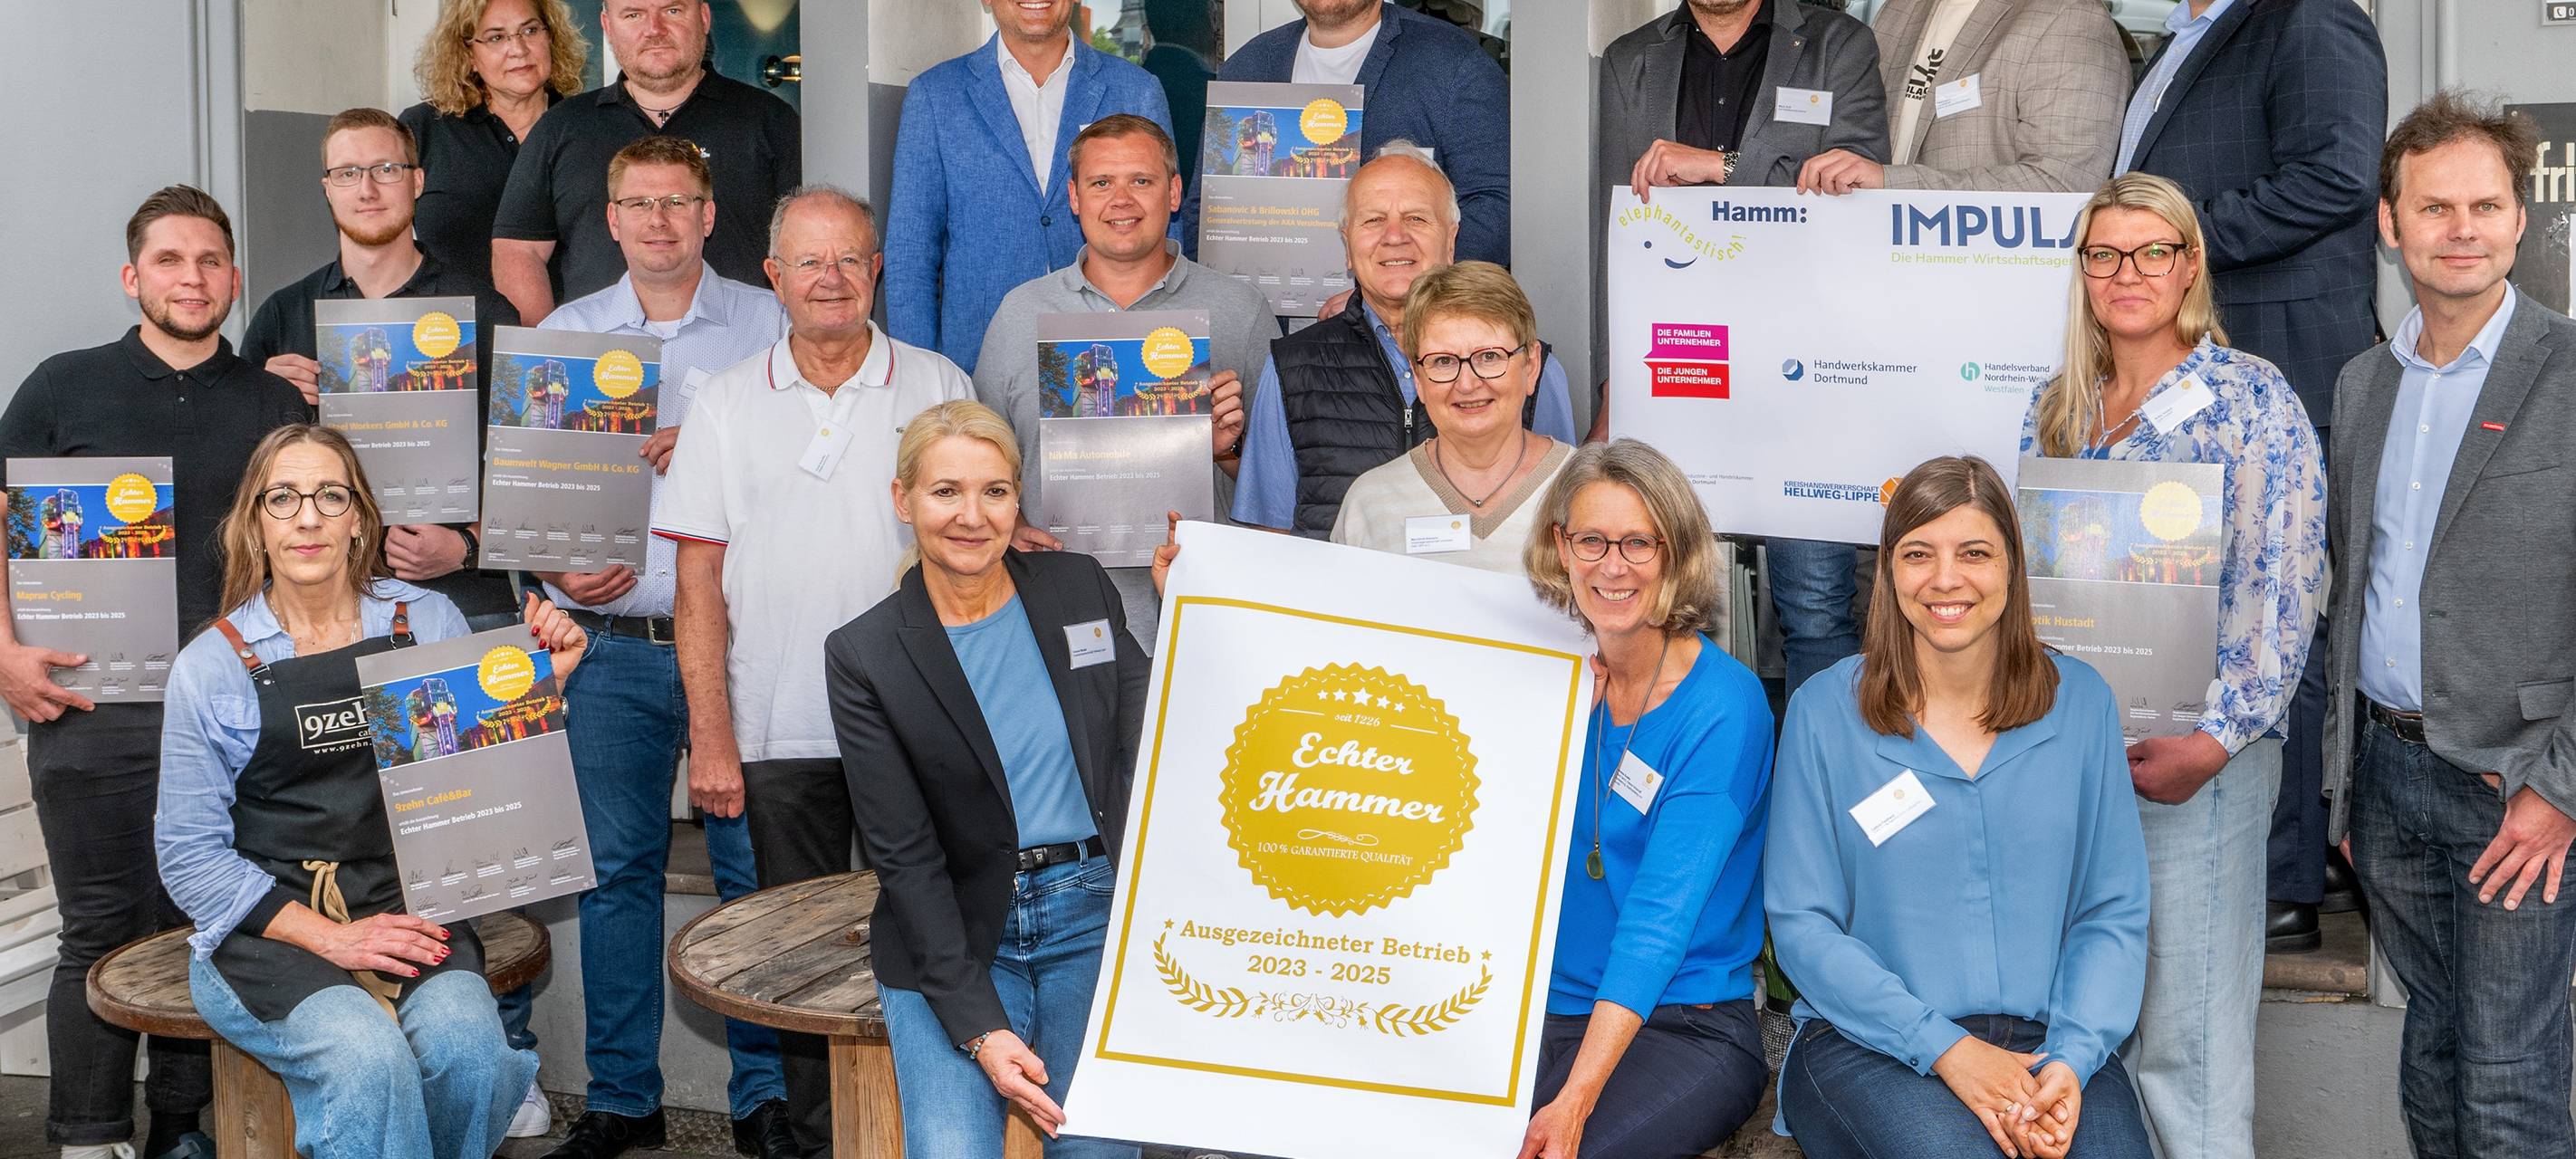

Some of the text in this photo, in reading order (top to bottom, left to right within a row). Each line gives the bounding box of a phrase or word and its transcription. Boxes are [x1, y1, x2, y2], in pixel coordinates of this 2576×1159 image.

[2530, 141, 2576, 203] fri
[1250, 206, 1257, 214] &
[1301, 207, 1320, 216] OHG
[1712, 201, 1807, 224] Hamm:
[1891, 252, 1912, 263] Die
[1916, 253, 1968, 264] Hammer
[1658, 329, 1711, 338] DIE FAMILIEN
[1658, 338, 1721, 347] UNTERNEHMER
[1673, 368, 1708, 376] JUNGEN
[1814, 359, 1918, 373] Handwerkskammer
[1985, 363, 2050, 373] Handelsverband
[1658, 376, 1722, 385] UNTERNEHMER
[1814, 373, 1868, 386] Dortmund
[1984, 385, 2025, 395] Westfalen
[385, 420, 409, 429] GmbH
[412, 420, 418, 428] &
[420, 419, 433, 428] Co.
[435, 419, 448, 428] KG
[371, 441, 392, 449] Betrieb
[493, 456, 639, 474] Baumwelt Wagner GmbH & Co. KG
[493, 479, 511, 487] Echter
[512, 480, 537, 488] Hammer
[1783, 480, 1879, 493] KREISHANDWERKERSCHAFT
[1784, 487, 1879, 503] HELLWEG-LIPPE
[50, 590, 83, 602] Cycling
[2054, 617, 2095, 627] Hustadt
[2077, 644, 2102, 653] Betrieb
[2103, 645, 2121, 654] 2023
[2123, 646, 2133, 654] bis
[2136, 647, 2153, 656] 2025
[304, 701, 369, 741] 9zeh
[1334, 712, 1380, 727] seit 1226
[1292, 732, 1414, 775] Echter
[395, 789, 473, 812] 9zehn Café&Bar
[1249, 771, 1446, 824] Hammer
[400, 801, 523, 835] Echter Hammer Betrieb 2023 bis 2025
[1257, 841, 1413, 866] 100 % GARANTIERTE QUALITÄT
[1179, 919, 1471, 964] Ausgezeichneter Betrieb
[1246, 954, 1307, 978] 2023
[1331, 963, 1391, 985] 2025
